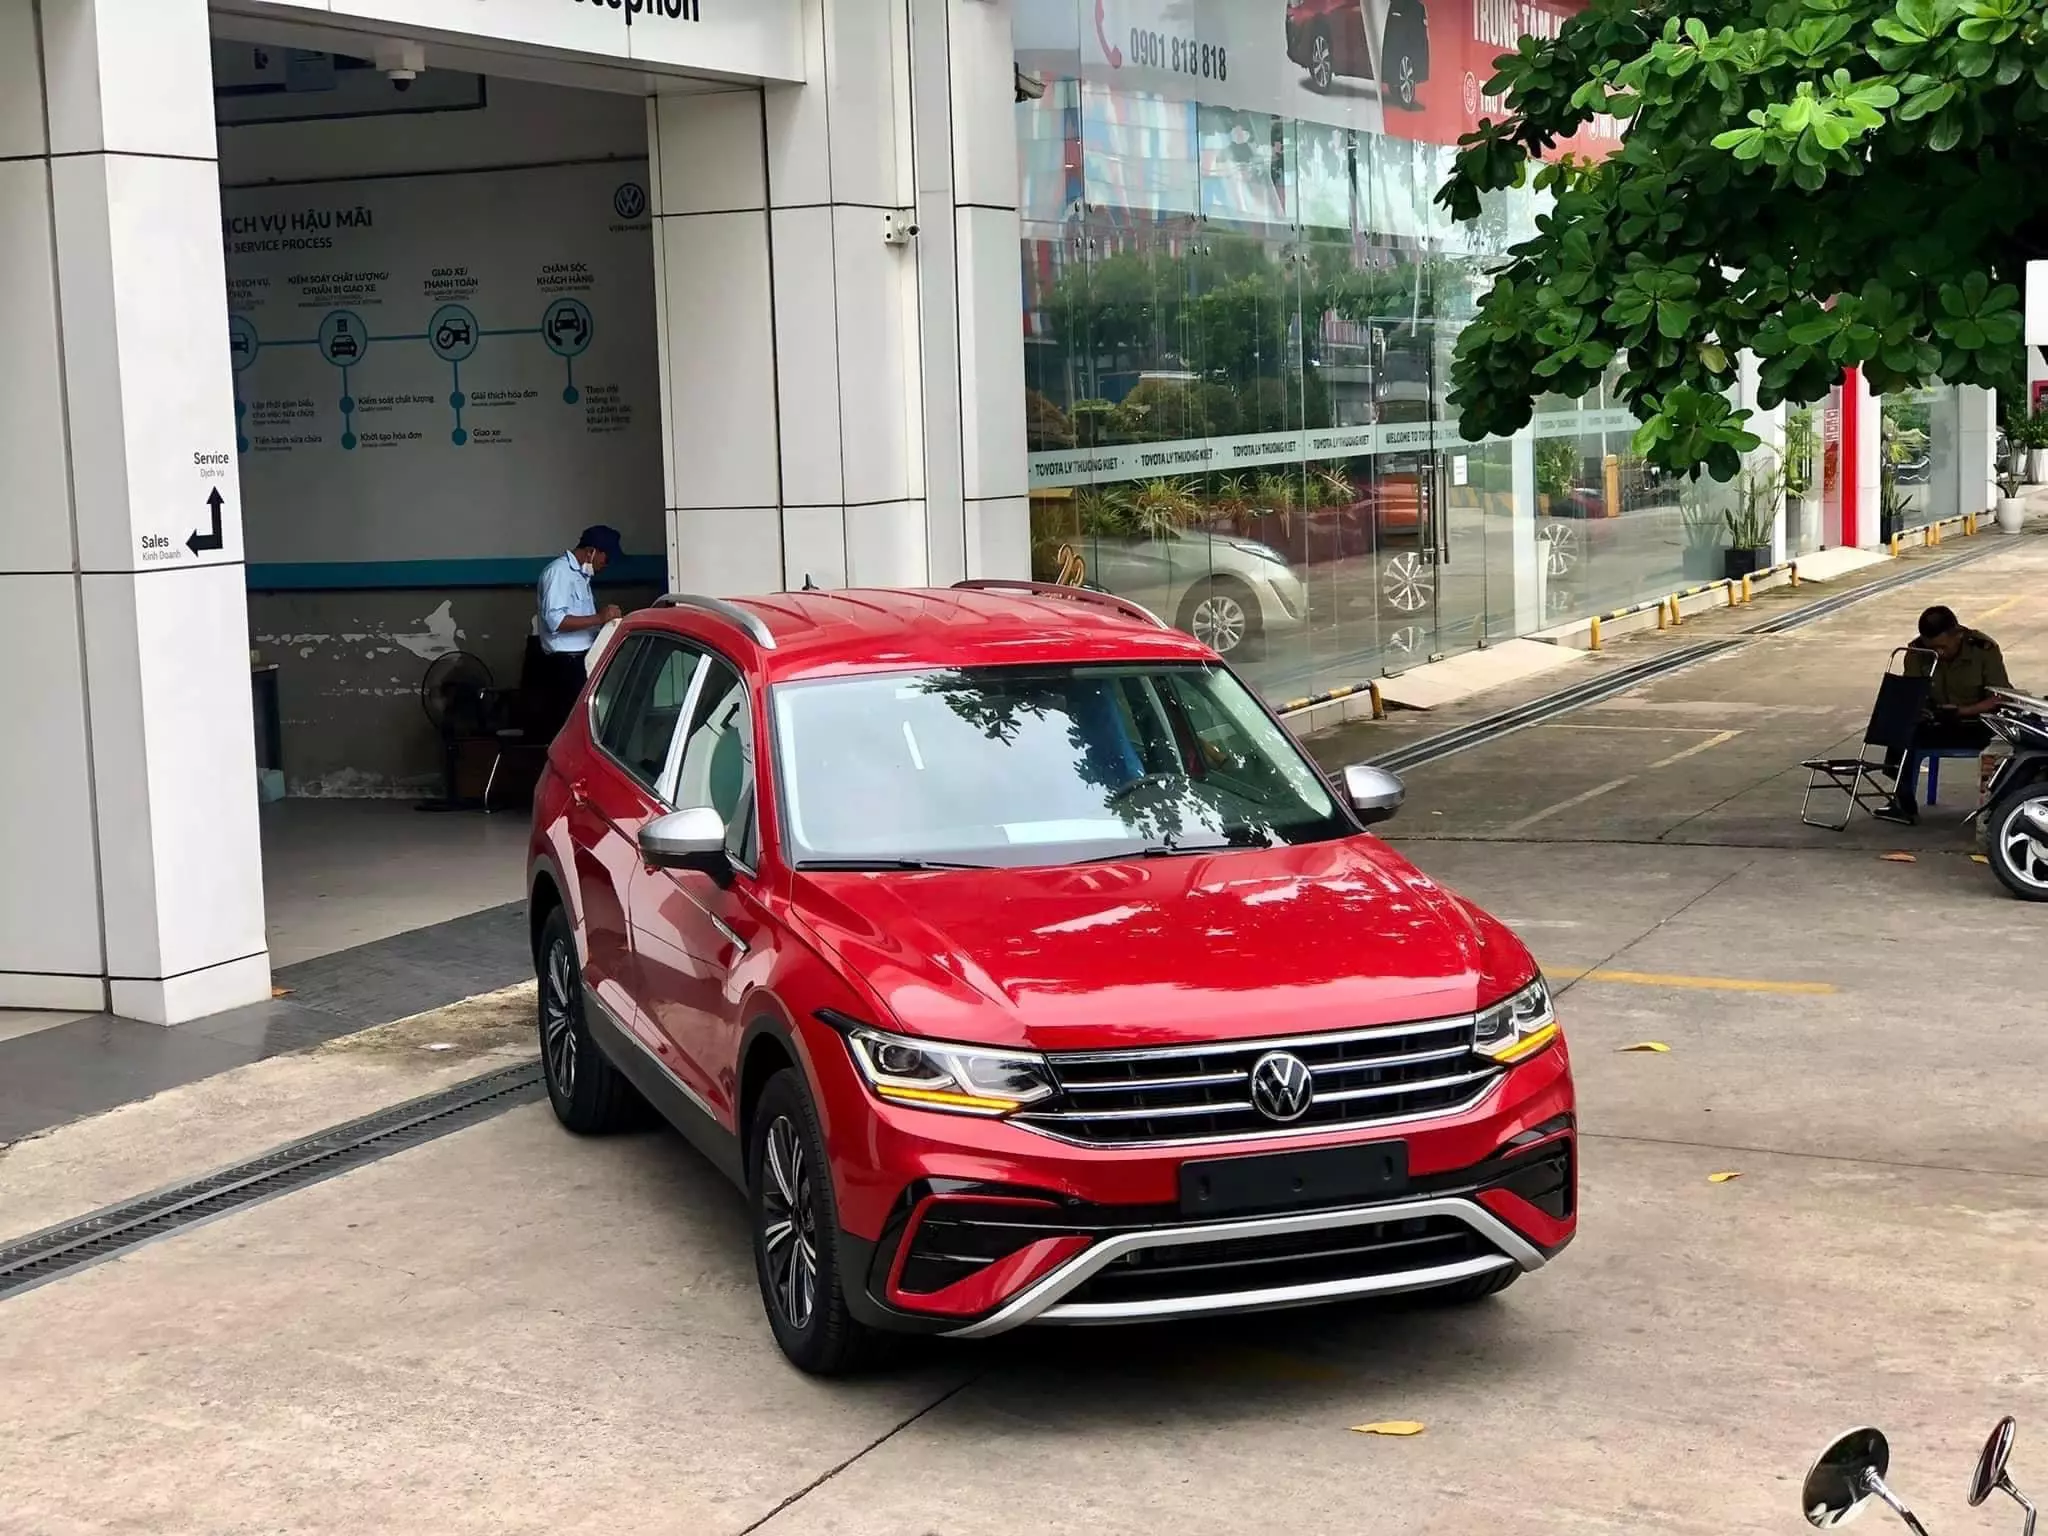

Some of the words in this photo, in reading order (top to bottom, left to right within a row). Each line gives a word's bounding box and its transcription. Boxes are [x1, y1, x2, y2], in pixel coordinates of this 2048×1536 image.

[1131, 27, 1165, 69] 0901
[1172, 36, 1198, 75] 818
[1202, 43, 1227, 82] 818
[261, 214, 287, 236] VỤ
[291, 208, 331, 233] HẬU
[234, 239, 280, 254] SERVICE
[282, 236, 333, 250] PROCESS
[193, 451, 229, 464] Service
[1141, 453, 1166, 467] TOYOTA
[1166, 451, 1173, 464] LY
[200, 468, 215, 479] Dịch
[1035, 461, 1064, 476] TOYOTA
[1065, 460, 1072, 474] LY
[1103, 457, 1118, 471] KIET
[142, 534, 169, 548] Sales
[142, 551, 158, 561] Kinh
[159, 549, 181, 560] Doanh
